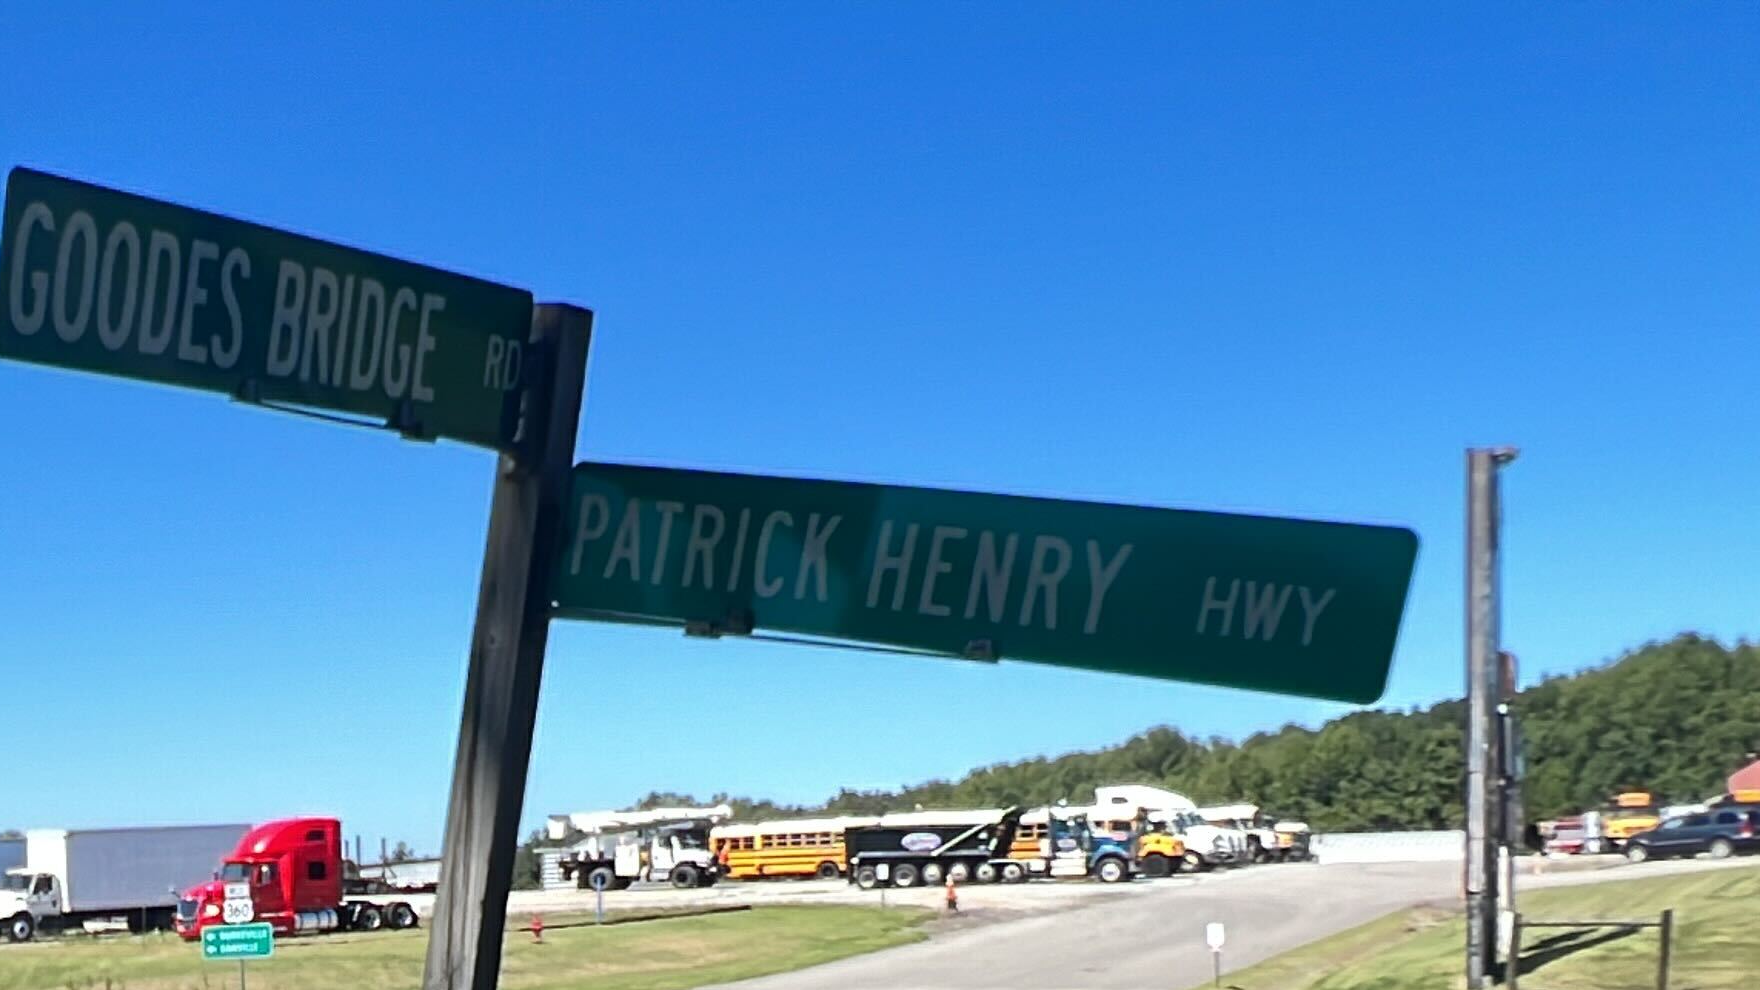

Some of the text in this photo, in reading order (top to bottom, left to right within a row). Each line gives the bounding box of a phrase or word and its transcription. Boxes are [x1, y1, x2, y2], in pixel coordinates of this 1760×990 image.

[8, 201, 523, 402] GOODES BRIDGE RD
[570, 493, 1337, 647] PATRICK HENRY HWY
[227, 903, 250, 918] 360
